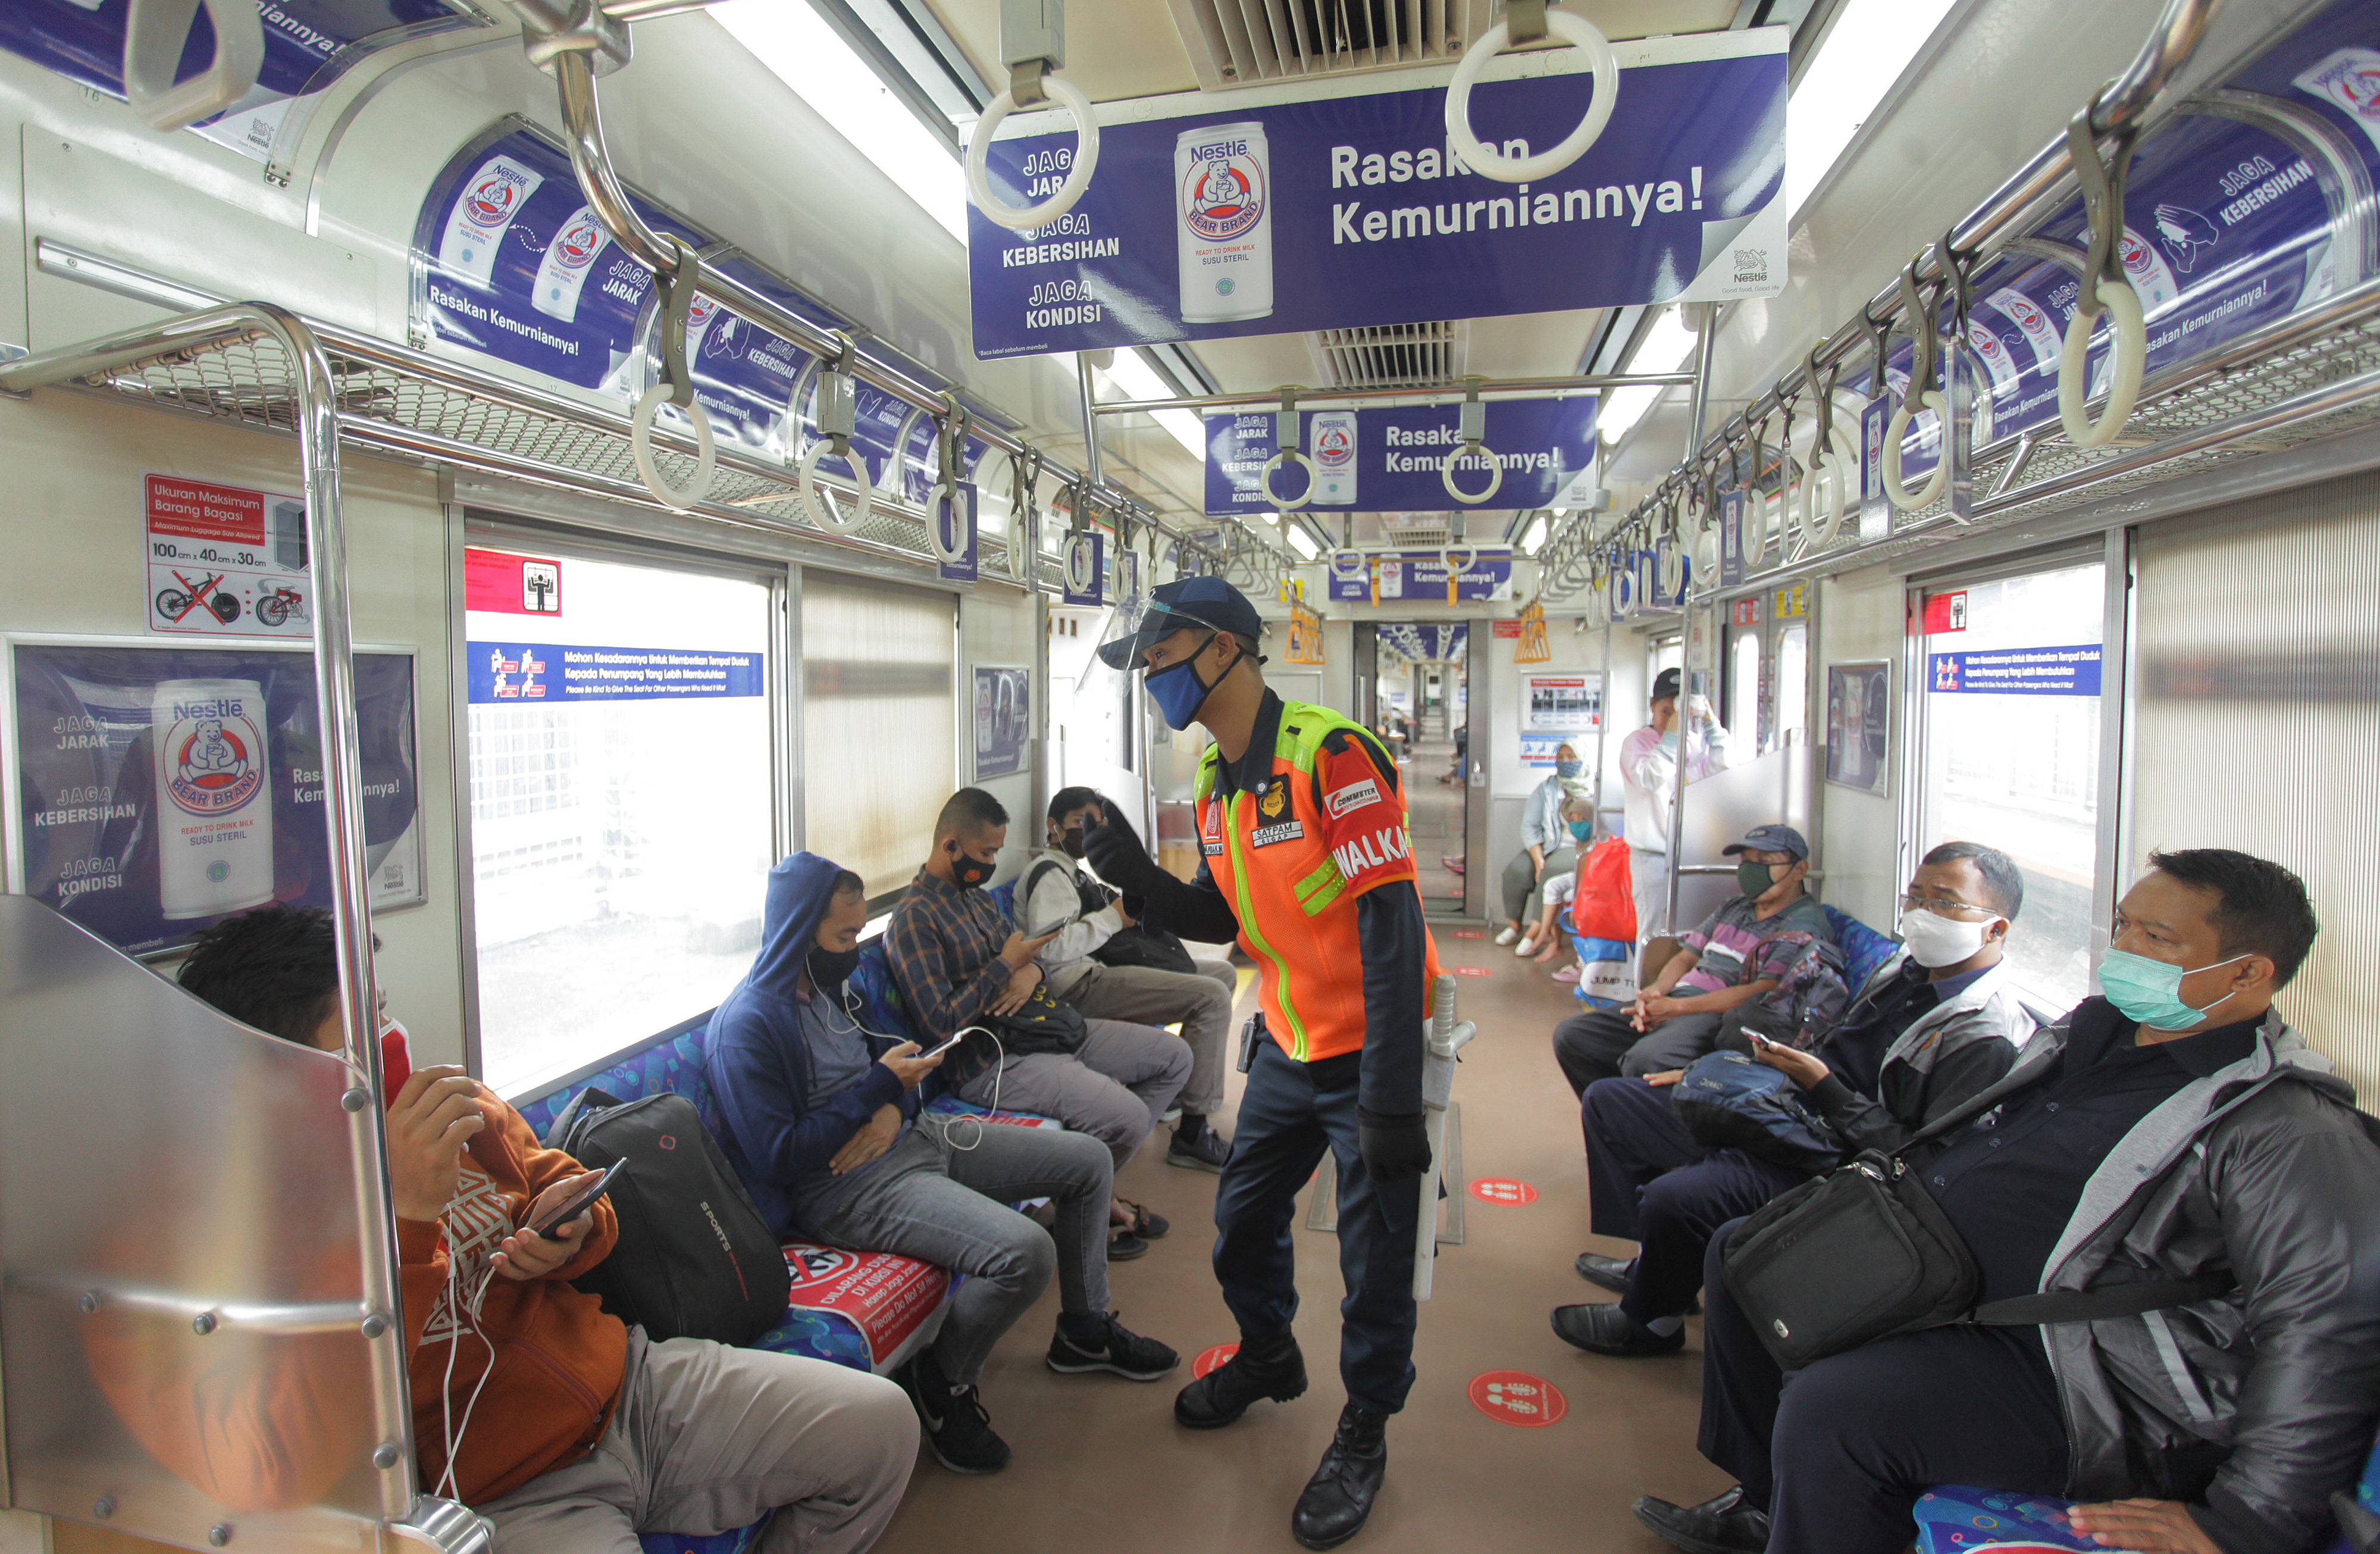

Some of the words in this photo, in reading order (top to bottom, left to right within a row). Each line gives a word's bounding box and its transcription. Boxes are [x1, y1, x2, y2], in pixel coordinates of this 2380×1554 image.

[84, 87, 99, 102] 16
[1191, 140, 1247, 163] Nestlé
[2219, 155, 2276, 197] JAGA
[2219, 160, 2315, 227] KEBERSIHAN
[468, 196, 478, 217] BEAR
[480, 211, 506, 221] BRAND
[1189, 209, 1217, 233] BEAR
[1220, 201, 1258, 233] BRAND
[1333, 167, 1703, 245] Kemurniannya!
[460, 229, 472, 239] SUSU
[472, 234, 486, 245] STERIL
[1003, 237, 1120, 268] KEBERSIHAN
[1195, 249, 1212, 257] READY
[1223, 246, 1241, 254] DRINK
[1202, 256, 1223, 265] SUSU
[1223, 254, 1250, 263] STERIL
[609, 260, 651, 290] JAGA
[602, 278, 642, 305] JARAK
[1028, 280, 1092, 307] JAGA
[430, 284, 488, 321] Rasakan
[490, 308, 580, 357] Kemurniannya!
[1026, 304, 1101, 329] KONDISI
[2146, 323, 2181, 354] asakan
[2182, 279, 2267, 336] Kemurniannya!
[766, 339, 796, 362] JAGA
[747, 348, 797, 380] KEBERSIHAN
[550, 384, 558, 393] 17
[693, 388, 750, 421] Kemurniannya!
[885, 399, 909, 417] JAGA
[2019, 387, 2058, 413] Kemurniann
[877, 410, 901, 429] KONDISI
[1234, 416, 1268, 429] JAGA
[1236, 429, 1268, 439] JARAK
[1386, 424, 1465, 446] Rasaka
[1234, 448, 1267, 460] JAGA
[155, 484, 196, 500] Ukuran
[199, 493, 260, 509] Maksimum
[1234, 479, 1263, 492] JAG
[1232, 493, 1267, 502] KONDIS
[155, 499, 200, 517] Barang
[204, 506, 243, 521] Bagasi
[155, 521, 190, 532] Maximum
[191, 525, 221, 536] Luggage
[236, 531, 260, 540] Allowed
[153, 543, 176, 558] 100
[178, 552, 191, 560] cm
[200, 549, 217, 562] 40
[238, 552, 253, 565] 30
[565, 651, 593, 662] Mohon
[594, 652, 647, 666] Kesadarannya
[649, 654, 668, 664] Untuk
[709, 656, 731, 667] Tempat
[731, 657, 749, 666] Duduk
[2080, 651, 2100, 661] Duduk
[565, 668, 598, 680] Kepada
[599, 668, 644, 681] Penumpang
[645, 668, 663, 681] Yang
[664, 669, 682, 679] Lebih
[682, 669, 726, 679] Membutuhkan
[174, 699, 243, 720] Nestlé
[53, 715, 109, 734] JAGA
[57, 734, 109, 750] JARAK
[57, 786, 112, 805] JAGA
[171, 777, 209, 805] BEAR
[212, 769, 258, 806] BRAND
[1338, 787, 1376, 807] COMMUTER
[35, 803, 137, 827] KEBERSIHAN
[181, 826, 203, 834] READY
[217, 822, 237, 830] DRINK
[190, 836, 213, 846] SUSU
[217, 831, 247, 842] STERIL
[1257, 823, 1292, 839] SATPAM
[1262, 834, 1288, 844] SIGAP
[61, 857, 116, 879] JAGA
[58, 874, 123, 897] KONDISI
[129, 937, 163, 951] membeli
[700, 1201, 731, 1252] SPORTS
[820, 1267, 873, 1304] DILARANG
[851, 1284, 870, 1296] DI
[863, 1267, 893, 1288] KURSI
[886, 1259, 906, 1270] INI
[863, 1288, 887, 1308] Harap
[885, 1274, 904, 1290] Jaga
[901, 1262, 921, 1278] Jarak
[871, 1311, 895, 1333] Please
[894, 1301, 906, 1313] Do
[906, 1289, 917, 1305] Not
[925, 1271, 942, 1286] Here
